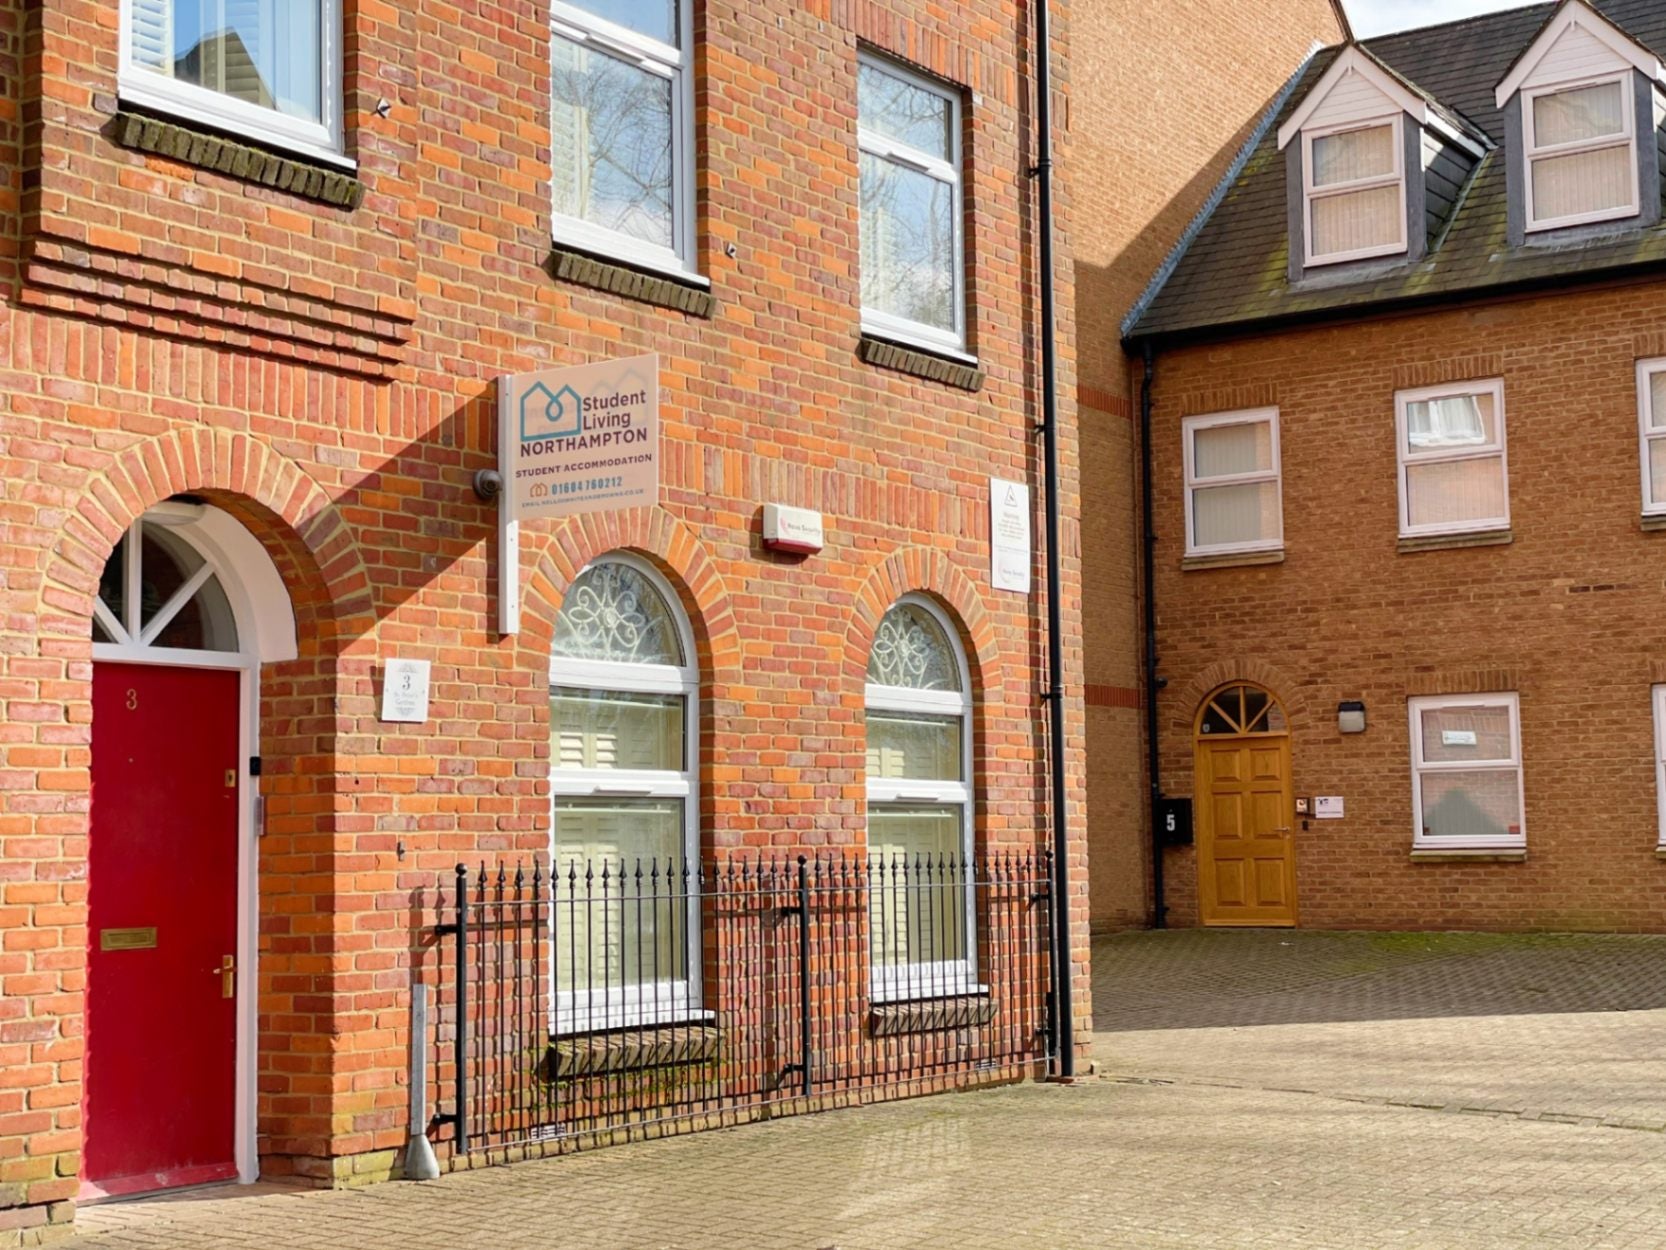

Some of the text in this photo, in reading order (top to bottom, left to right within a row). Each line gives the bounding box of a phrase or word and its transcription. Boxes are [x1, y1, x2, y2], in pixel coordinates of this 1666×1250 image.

[583, 389, 646, 412] Student
[583, 412, 631, 431] Living
[520, 428, 647, 457] NORTHAMPTON
[515, 454, 652, 478] STUDENT ACCOMMODATION
[551, 476, 623, 495] 01604 760212
[402, 674, 411, 691] 3
[126, 688, 138, 710] 3
[1166, 814, 1176, 831] 5
